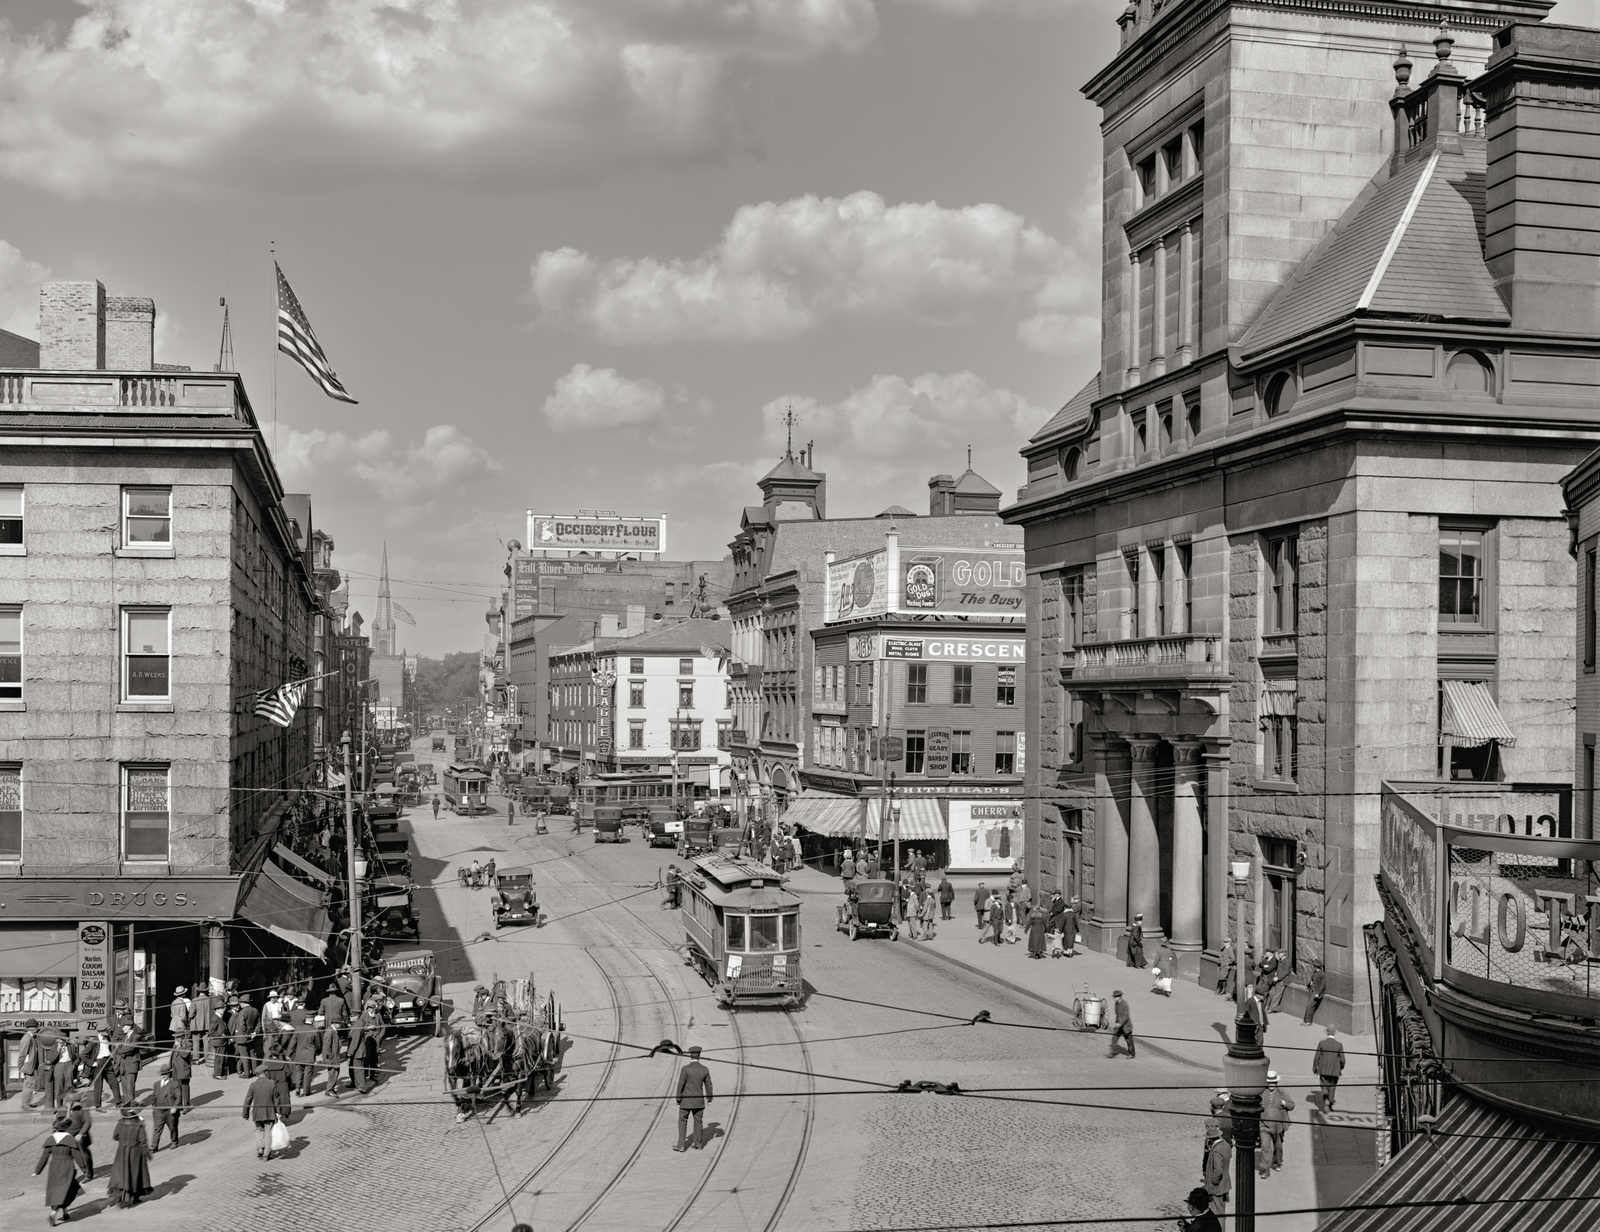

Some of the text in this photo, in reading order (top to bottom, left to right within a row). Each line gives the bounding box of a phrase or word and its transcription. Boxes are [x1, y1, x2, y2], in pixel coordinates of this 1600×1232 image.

[555, 522, 657, 538] OCCIDENT FLOUR
[518, 561, 536, 574] Fall
[538, 562, 562, 574] River
[583, 562, 606, 574] Globe
[952, 560, 1026, 588] GOLD
[907, 583, 927, 594] GOLD
[916, 588, 934, 599] DUST
[960, 593, 1023, 610] The Busy
[928, 642, 1024, 657] CRESCEN
[345, 650, 355, 726] MOHICA
[600, 688, 608, 737] EAGLE
[972, 807, 1008, 816] CHERRY
[89, 892, 197, 906] DRUGS.
